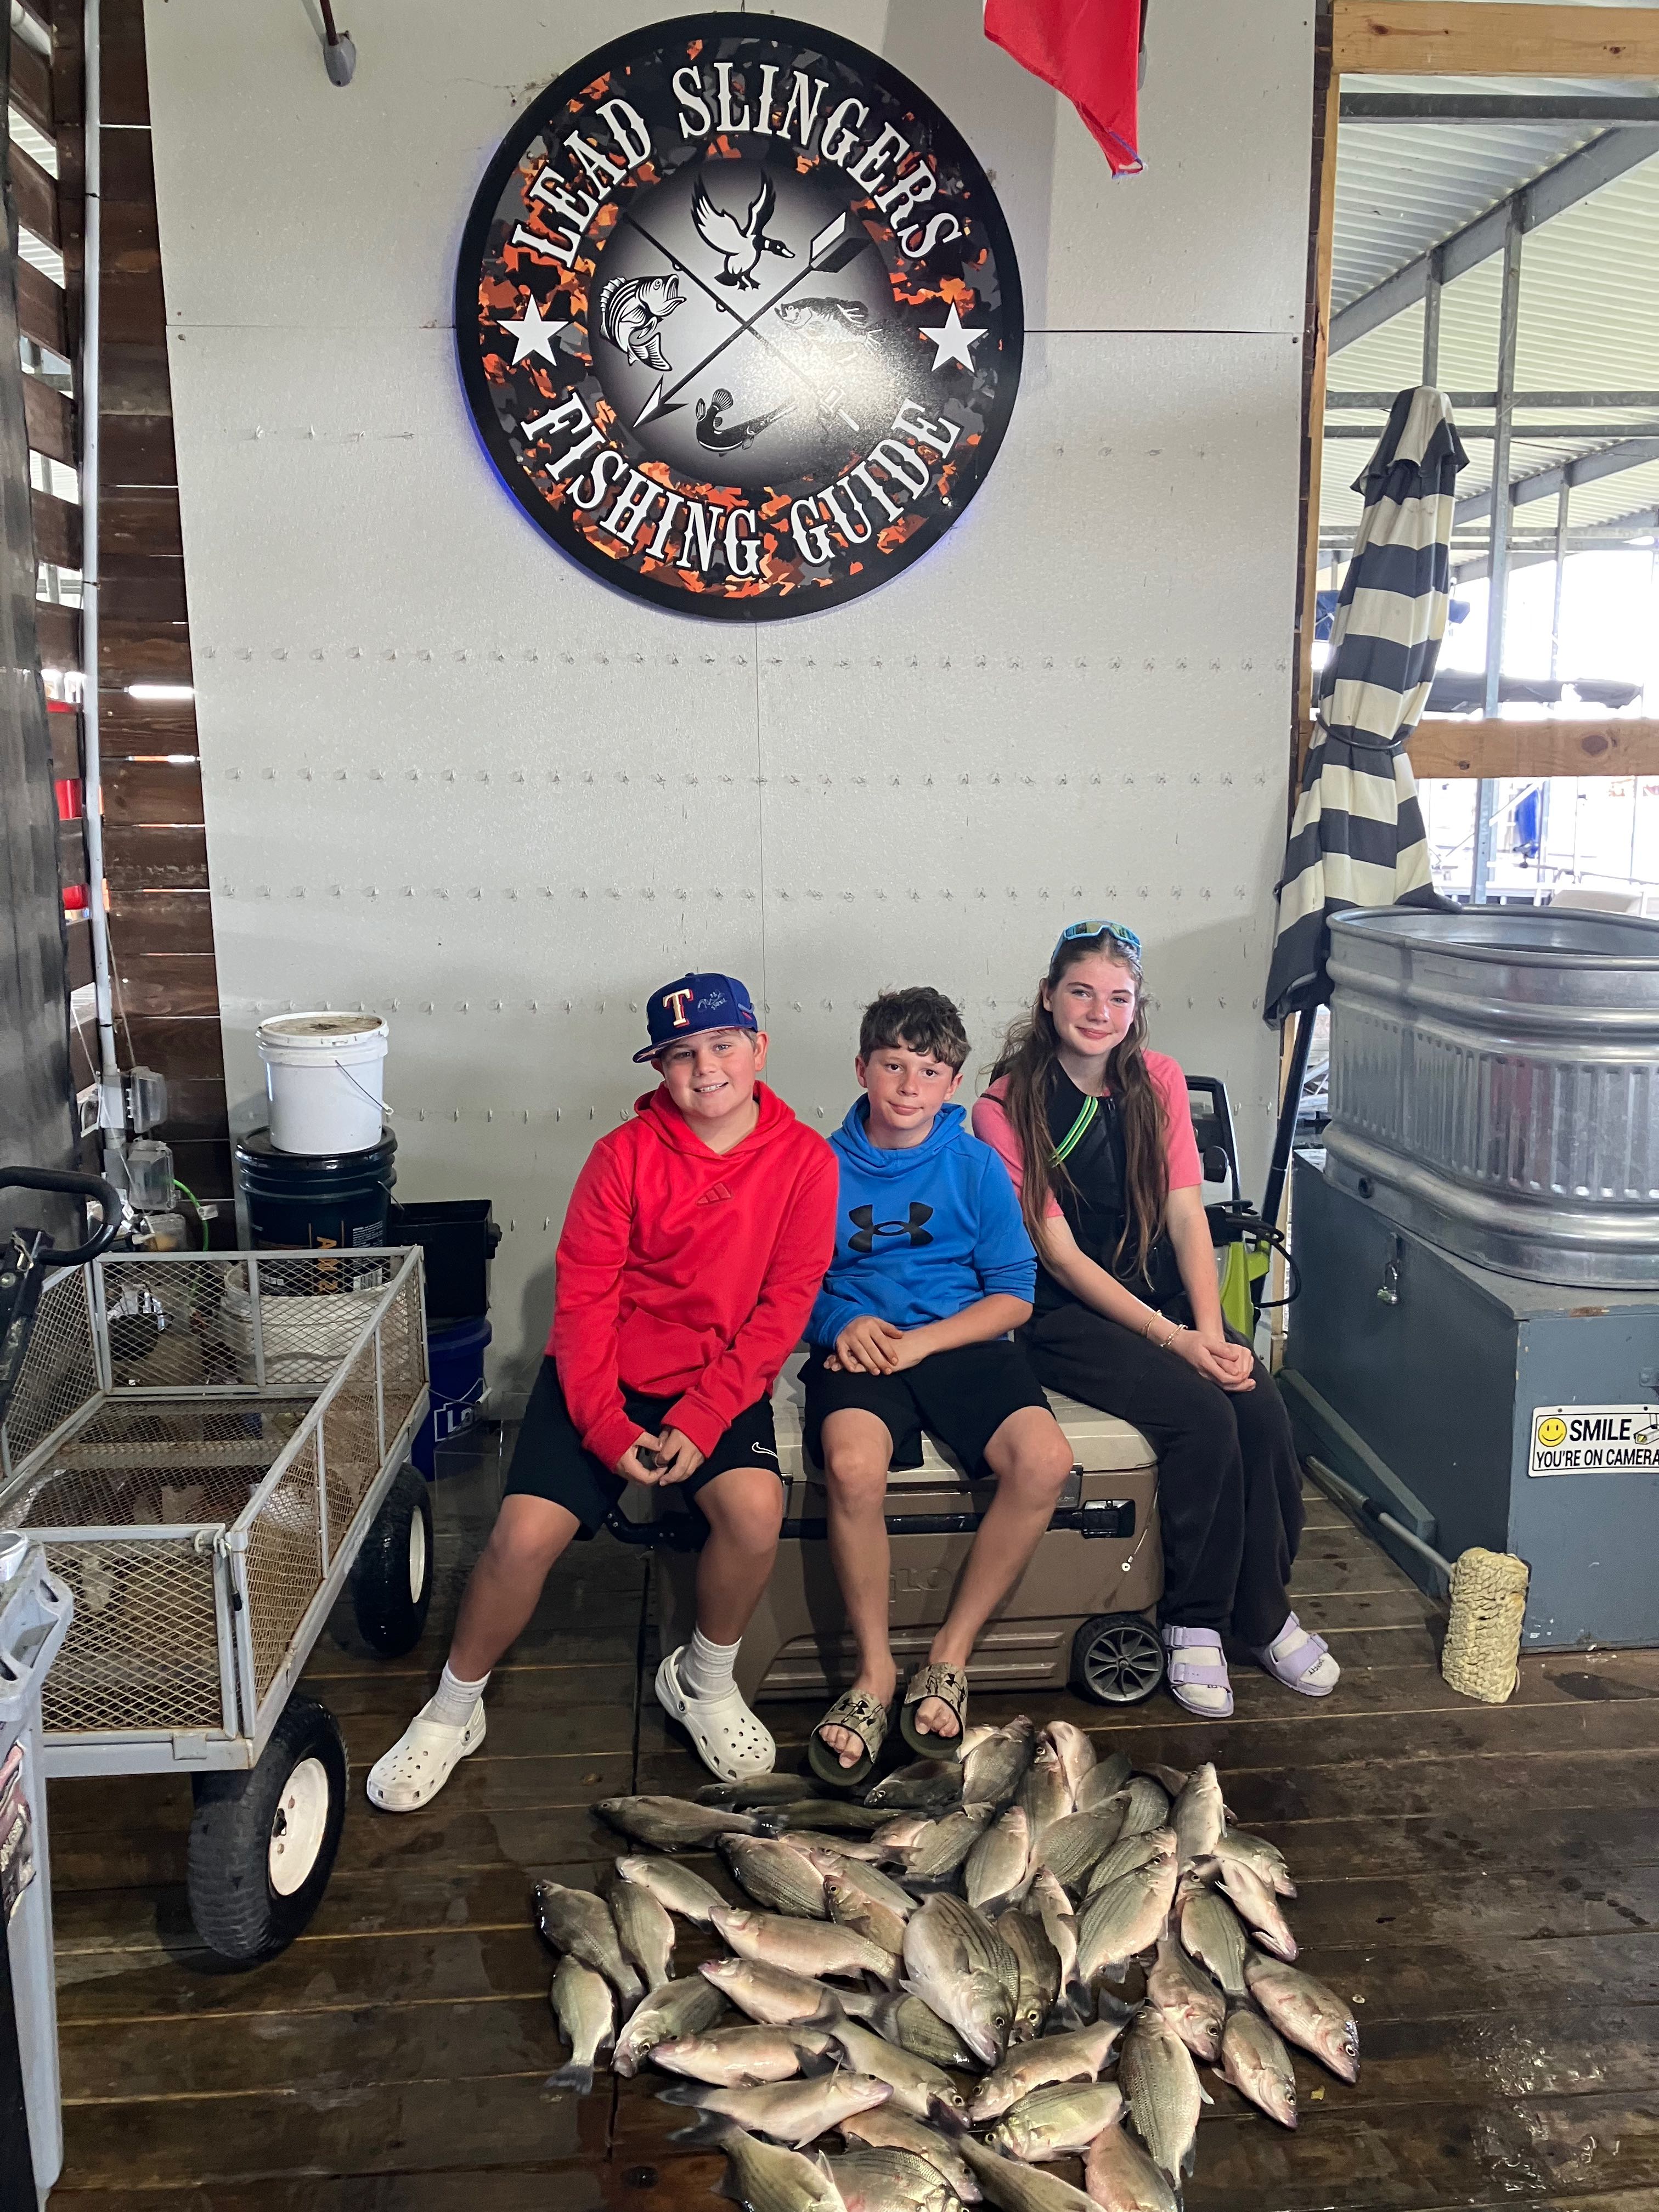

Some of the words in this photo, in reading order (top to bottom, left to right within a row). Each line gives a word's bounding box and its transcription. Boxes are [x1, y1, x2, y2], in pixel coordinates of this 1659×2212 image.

[511, 99, 651, 268] LEAD
[673, 63, 962, 258] SLINGERS
[520, 391, 761, 575] FISHING
[791, 400, 961, 565] GUIDE
[663, 988, 693, 1028] T
[1569, 1418, 1632, 1442] SMILE
[1537, 1450, 1581, 1468] YOU'RE
[1584, 1449, 1604, 1466] ON
[1606, 1448, 1659, 1465] CAMERA
